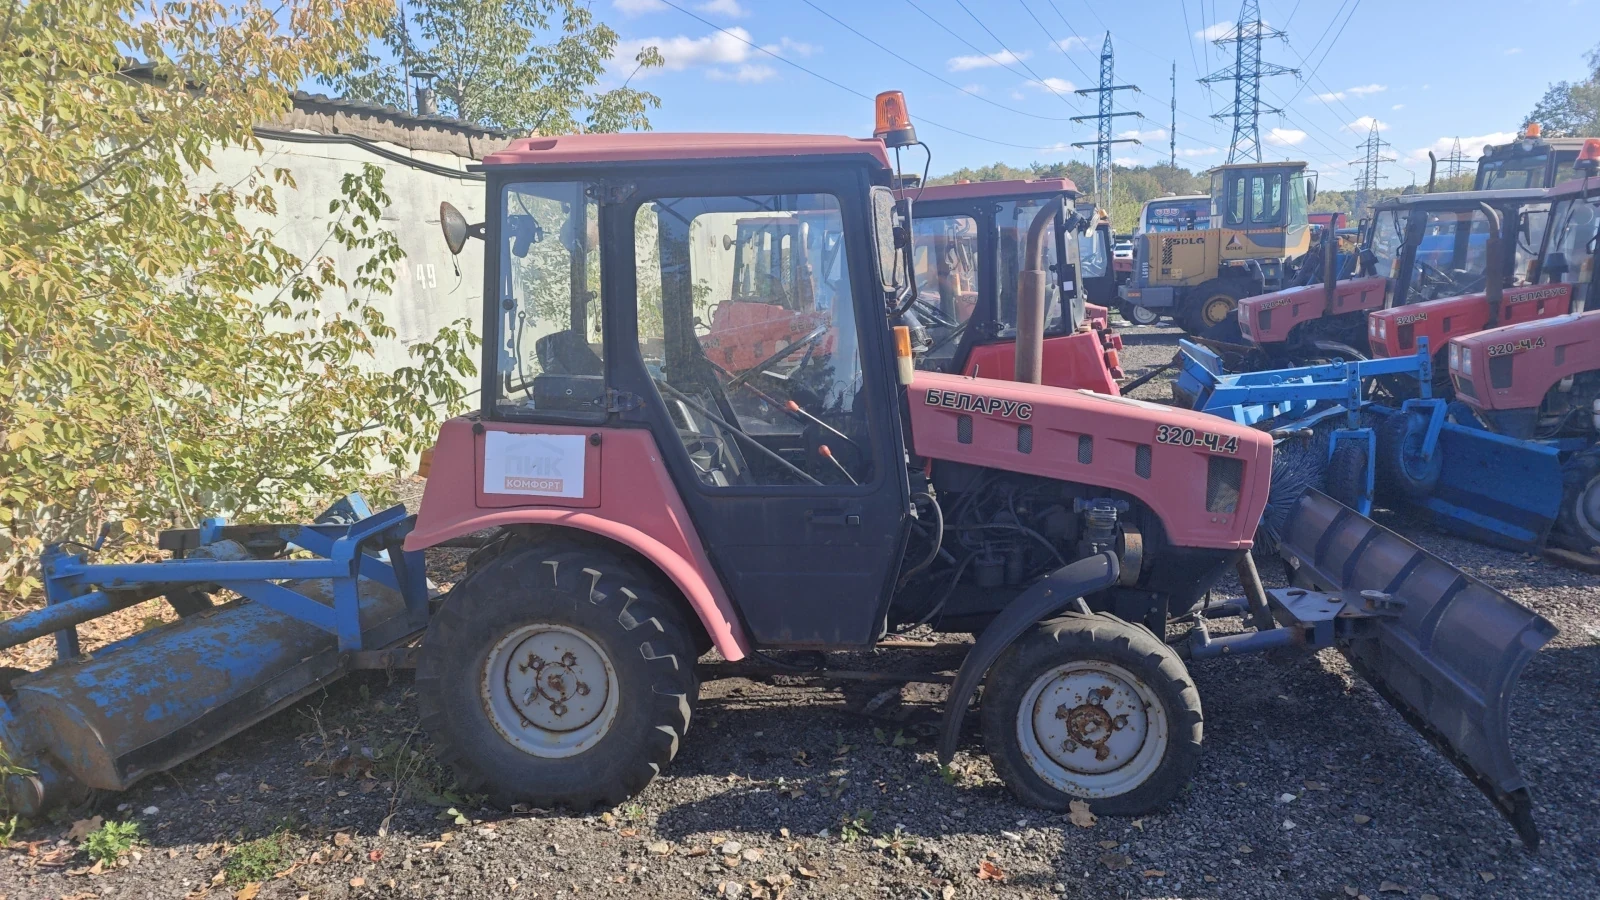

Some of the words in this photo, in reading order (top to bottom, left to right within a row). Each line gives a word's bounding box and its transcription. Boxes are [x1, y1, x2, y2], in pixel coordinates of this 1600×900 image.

[1171, 237, 1205, 245] SDLG
[416, 263, 437, 290] 49
[1510, 287, 1568, 303] БЕЛАРУС
[1397, 312, 1428, 326] 320-Ч
[1487, 336, 1546, 357] 320-Ч.4
[925, 388, 1033, 420] БЕЛАРУС
[1155, 424, 1240, 454] 320-Ч.4
[505, 455, 564, 477] ПИК
[506, 479, 561, 490] КОМФОРТ
